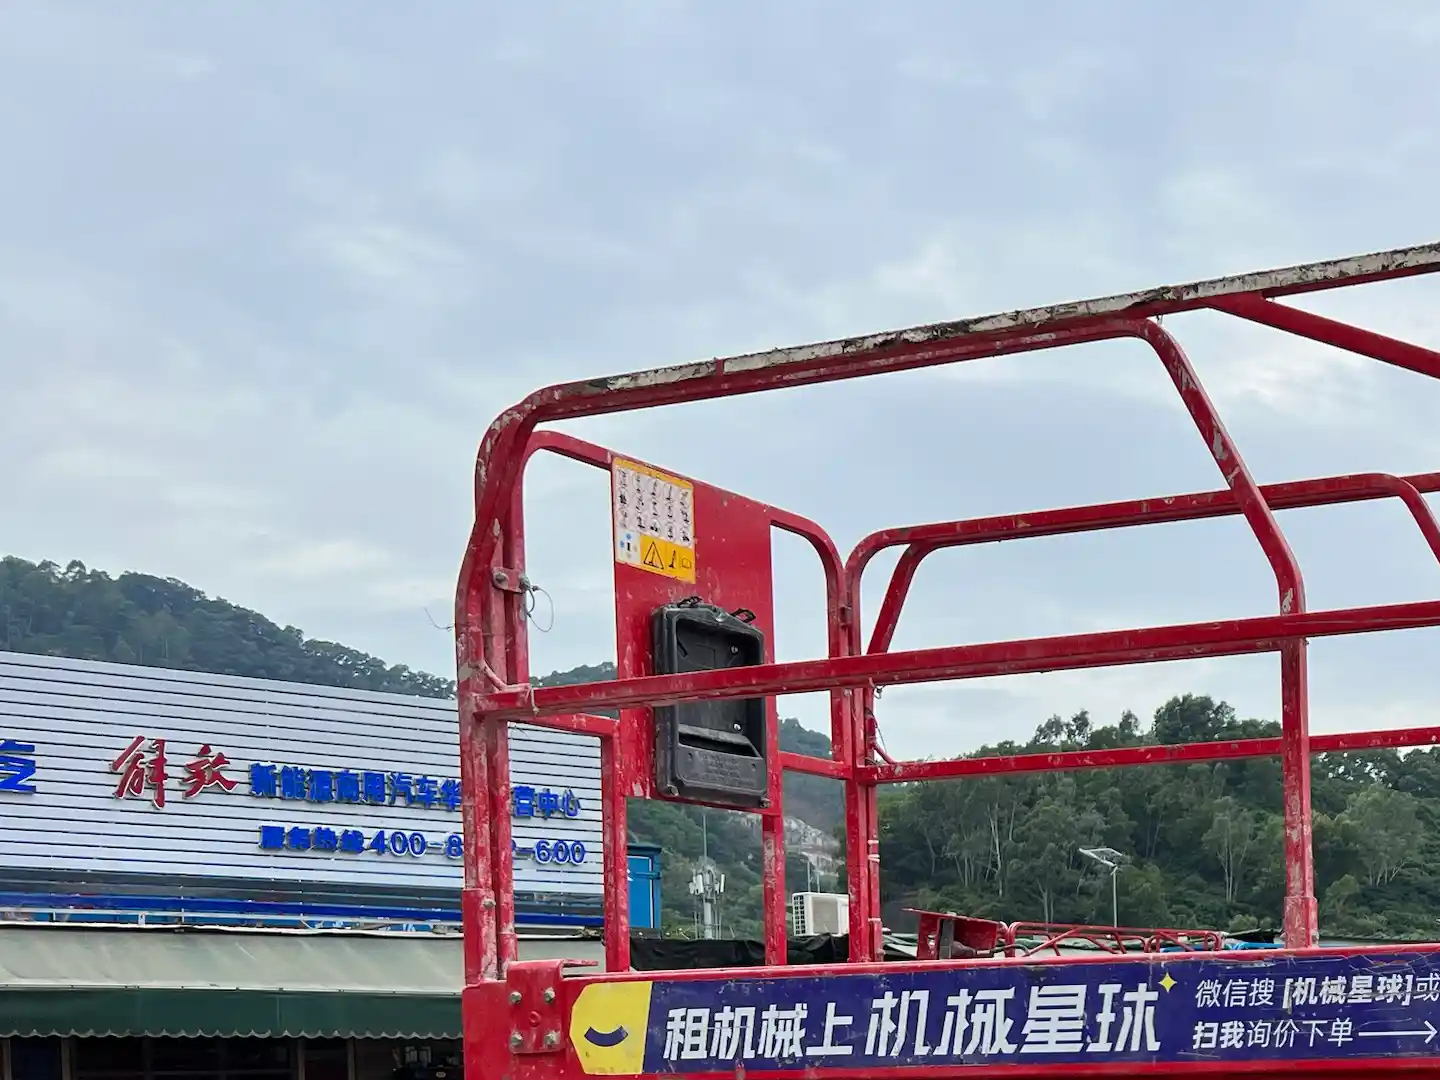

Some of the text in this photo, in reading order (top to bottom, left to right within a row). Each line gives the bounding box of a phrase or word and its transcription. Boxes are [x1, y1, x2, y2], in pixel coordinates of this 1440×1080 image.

[1192, 1016, 1355, 1050] 扫我询价下单
